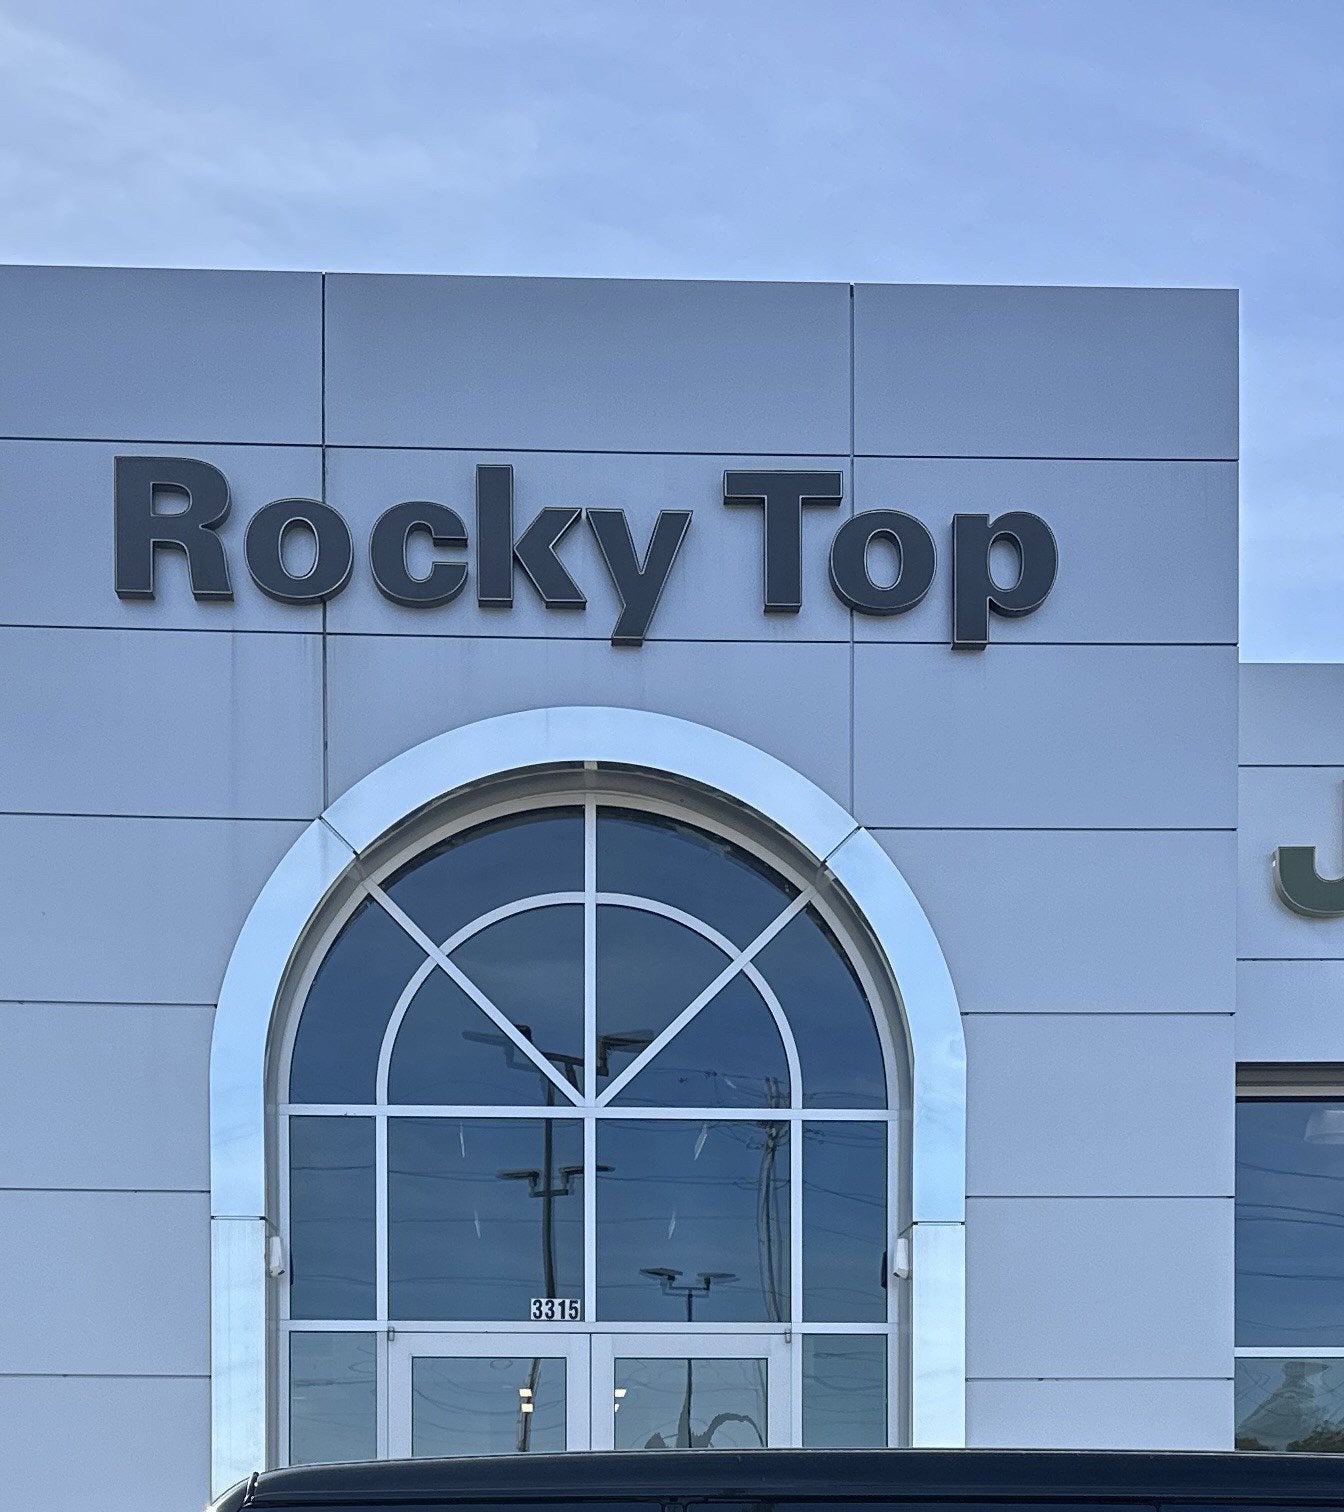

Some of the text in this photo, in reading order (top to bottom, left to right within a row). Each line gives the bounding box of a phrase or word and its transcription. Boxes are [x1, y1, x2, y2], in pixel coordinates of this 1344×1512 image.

[113, 456, 1059, 651] Rocky Top
[532, 1299, 579, 1320] 3315
